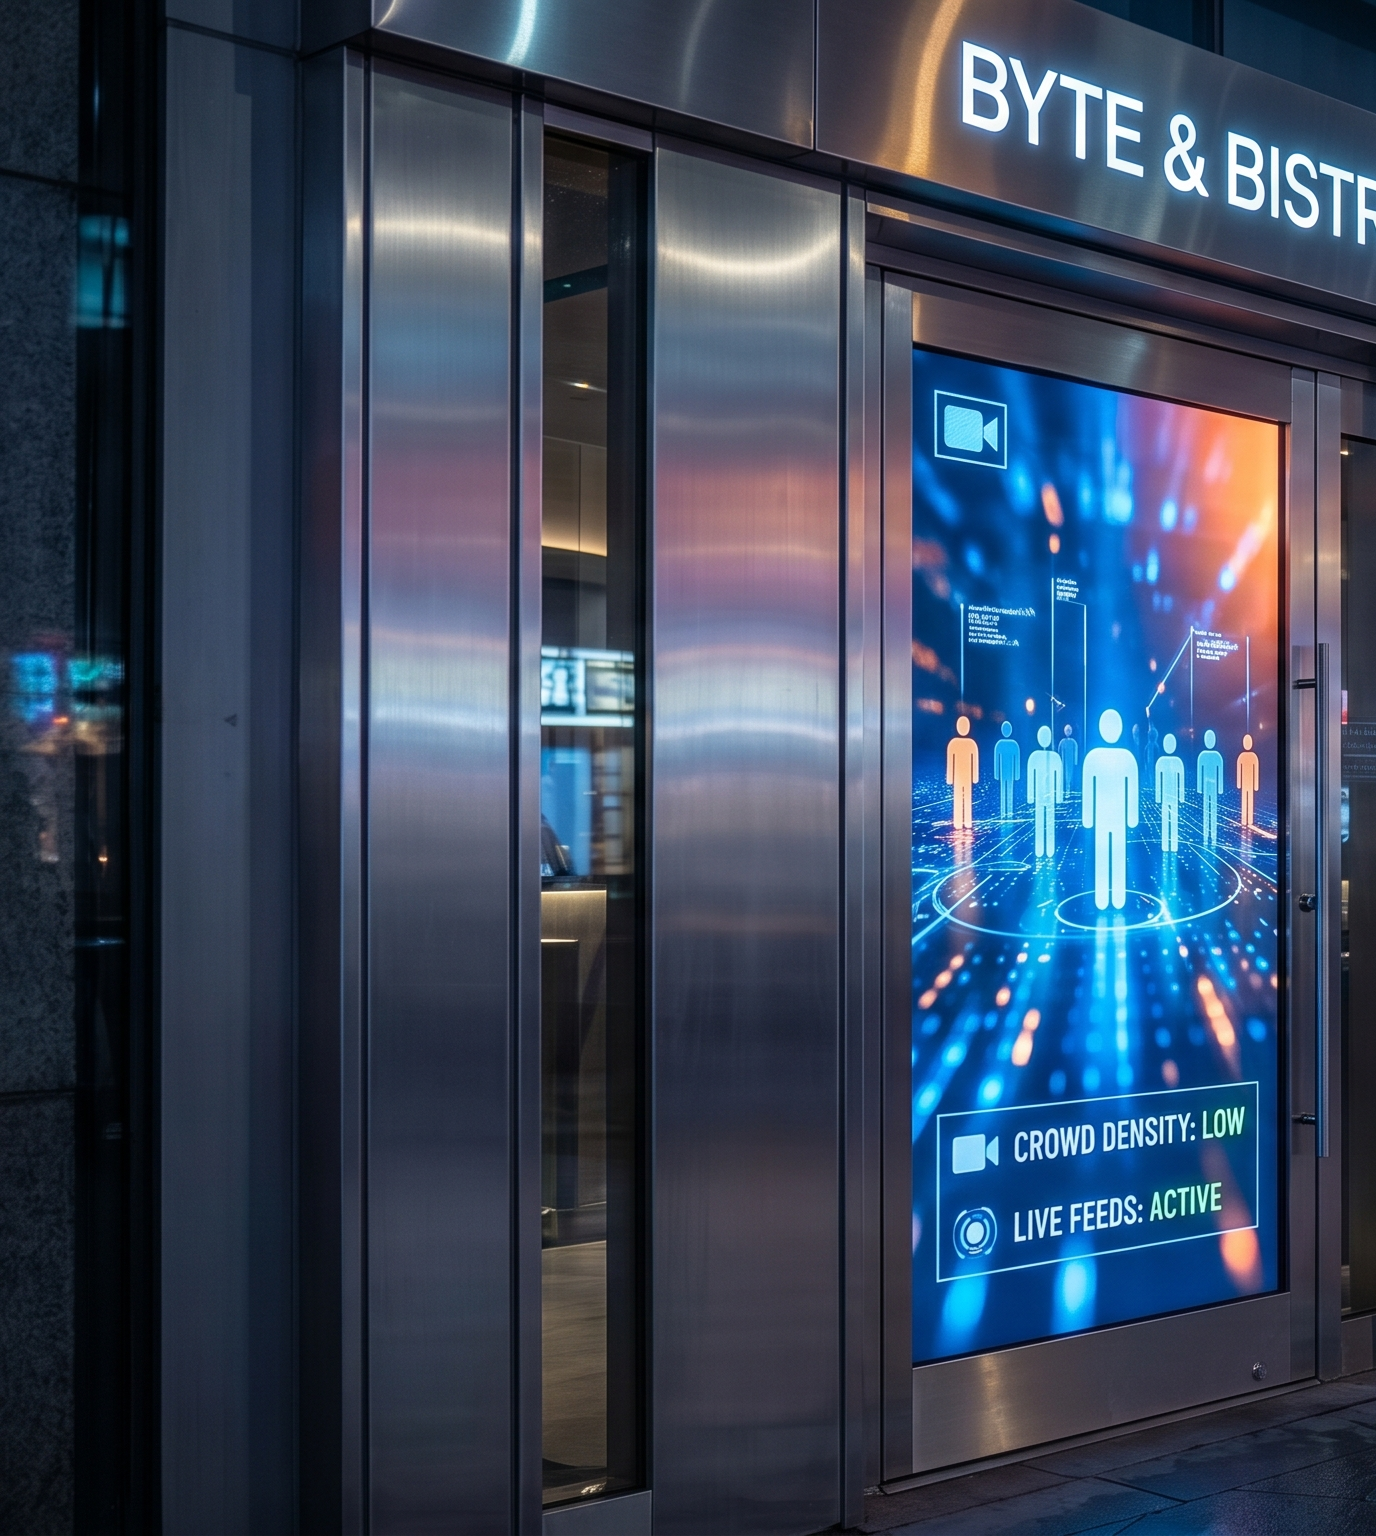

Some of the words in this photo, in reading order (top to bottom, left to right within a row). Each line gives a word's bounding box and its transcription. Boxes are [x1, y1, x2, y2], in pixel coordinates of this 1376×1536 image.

[962, 41, 1144, 178] BYTE
[1163, 113, 1209, 198] &
[1014, 1124, 1095, 1163] CROWD
[1103, 1112, 1196, 1152] DENSITY:
[1202, 1106, 1245, 1139] LOW
[1014, 1206, 1063, 1242] LIVE
[1070, 1195, 1143, 1233] FEEDS:
[1150, 1181, 1222, 1222] ACTIVE
